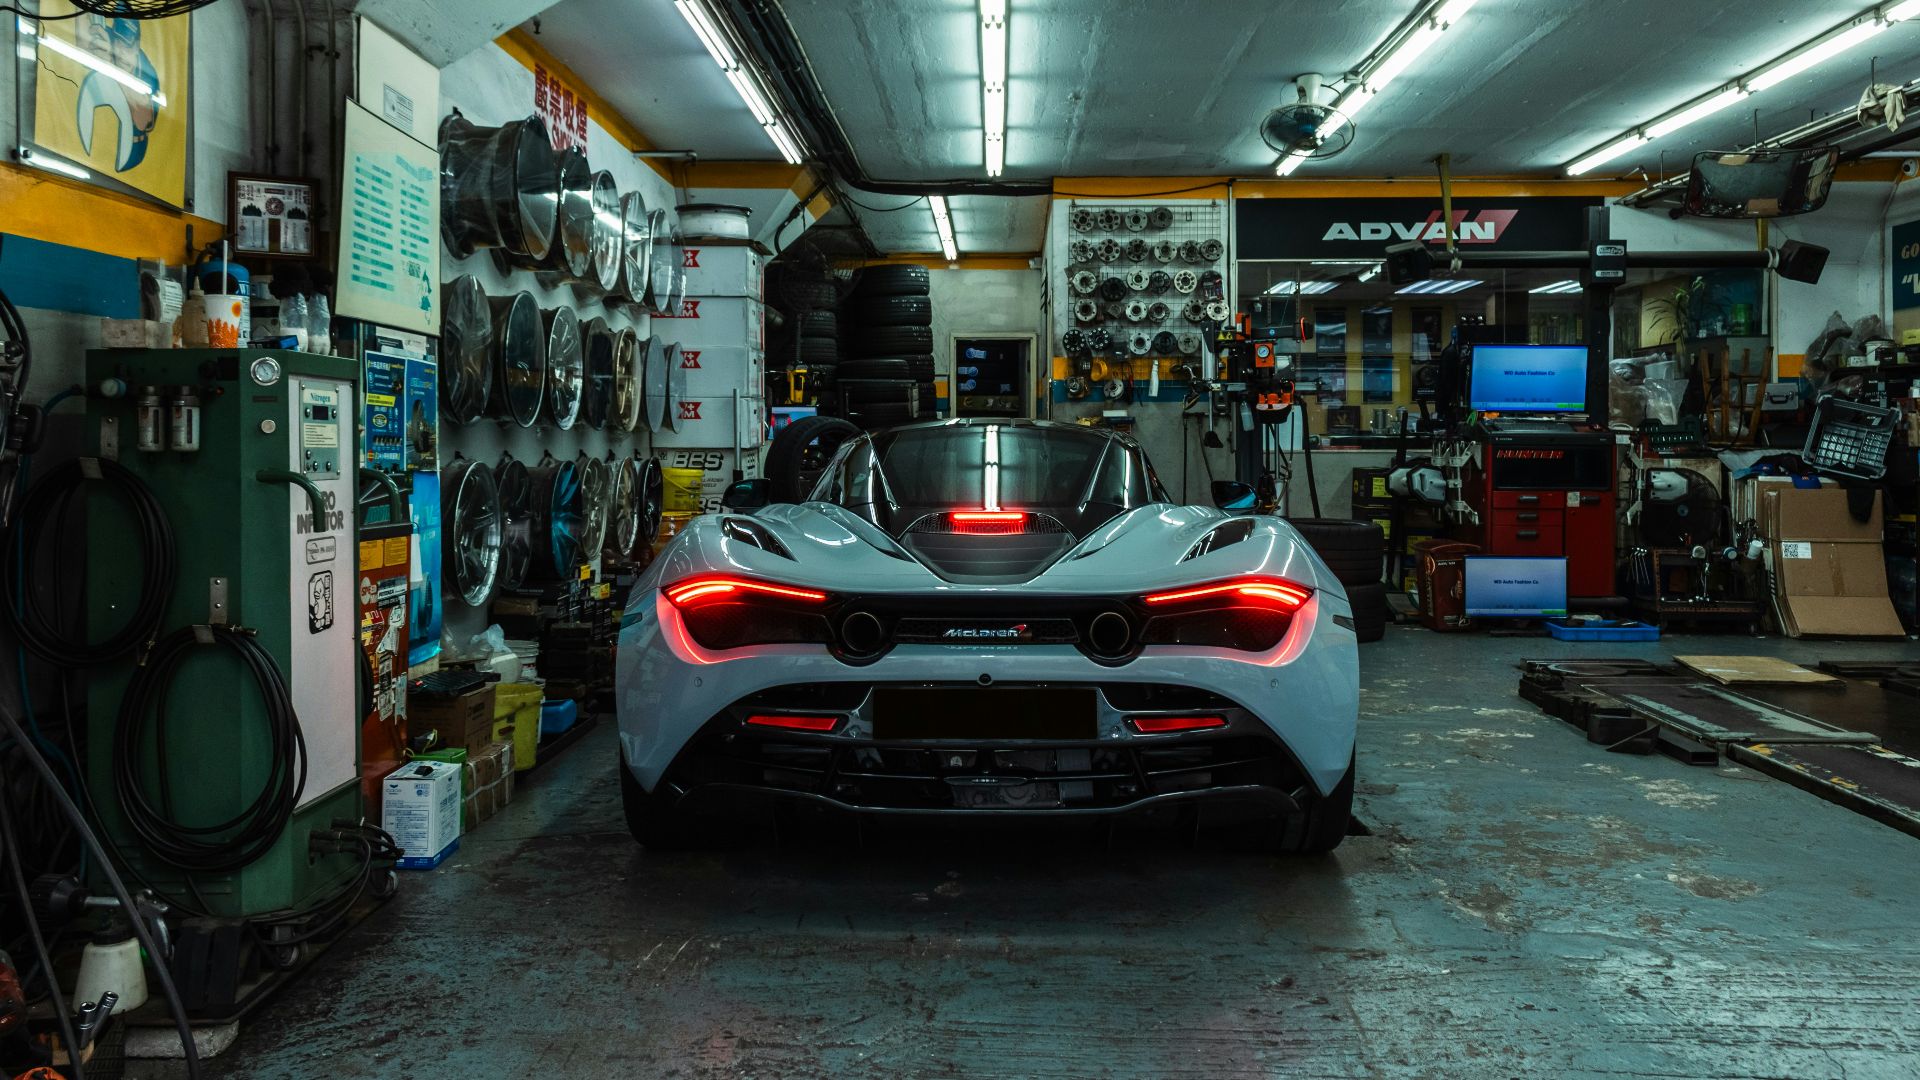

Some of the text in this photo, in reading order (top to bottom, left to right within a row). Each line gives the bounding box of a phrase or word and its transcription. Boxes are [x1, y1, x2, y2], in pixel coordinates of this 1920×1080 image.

[1322, 221, 1496, 241] ADVAN
[310, 392, 331, 403] Nitrogen
[672, 451, 724, 471] BBS
[306, 490, 336, 511] NRO
[297, 510, 344, 534] INFTOR
[943, 628, 1018, 638] McLaren
